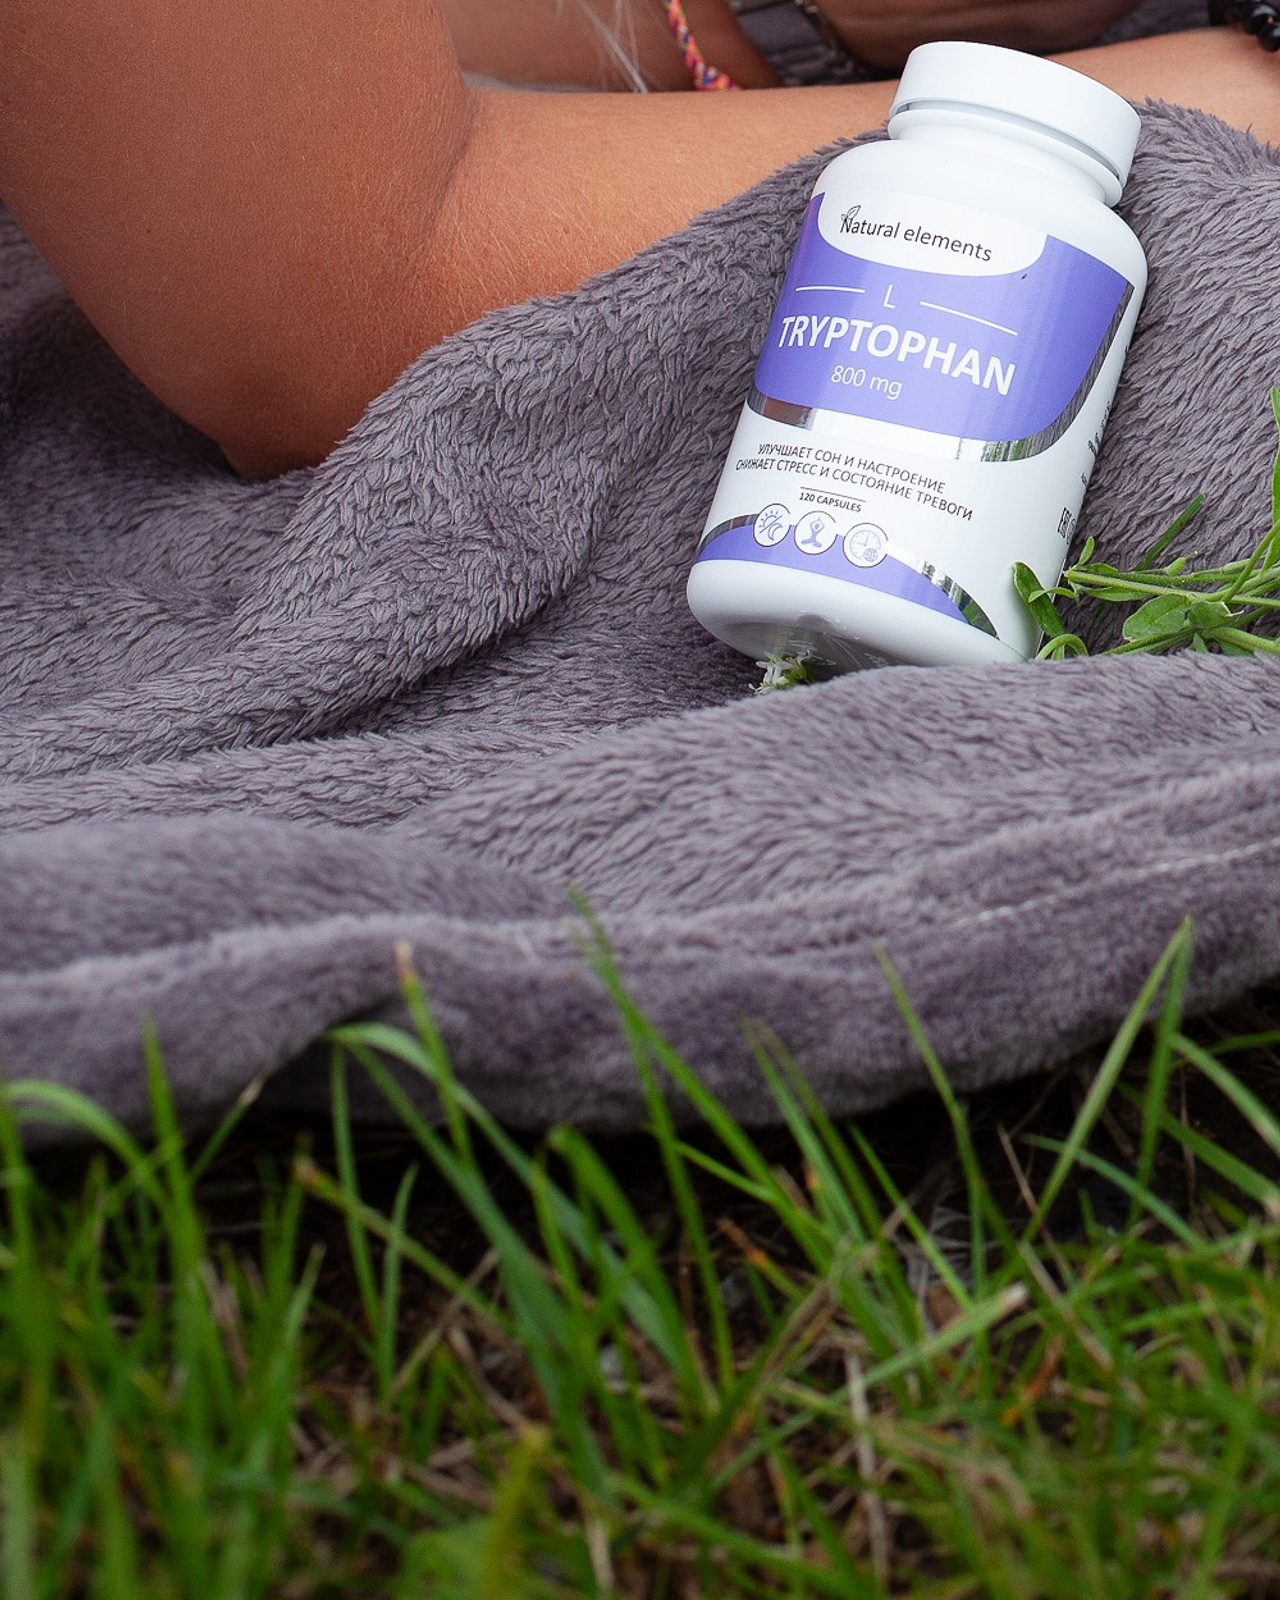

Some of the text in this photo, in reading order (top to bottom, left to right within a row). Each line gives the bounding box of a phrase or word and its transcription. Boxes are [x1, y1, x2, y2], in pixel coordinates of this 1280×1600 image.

[840, 217, 993, 262] Natural elements
[883, 284, 896, 309] L
[778, 314, 1016, 396] TRYPTOPHAN
[831, 364, 903, 400] 800 mg
[736, 458, 973, 521] СНИЖАЕТ СТРЕСС И СОСТОЯНИЕ ТРЕВОГИ
[757, 443, 946, 494] УЛУЧШАЕТ СОН И НАСТРОЕНИЕ
[799, 492, 862, 512] 120 CAPSULES
